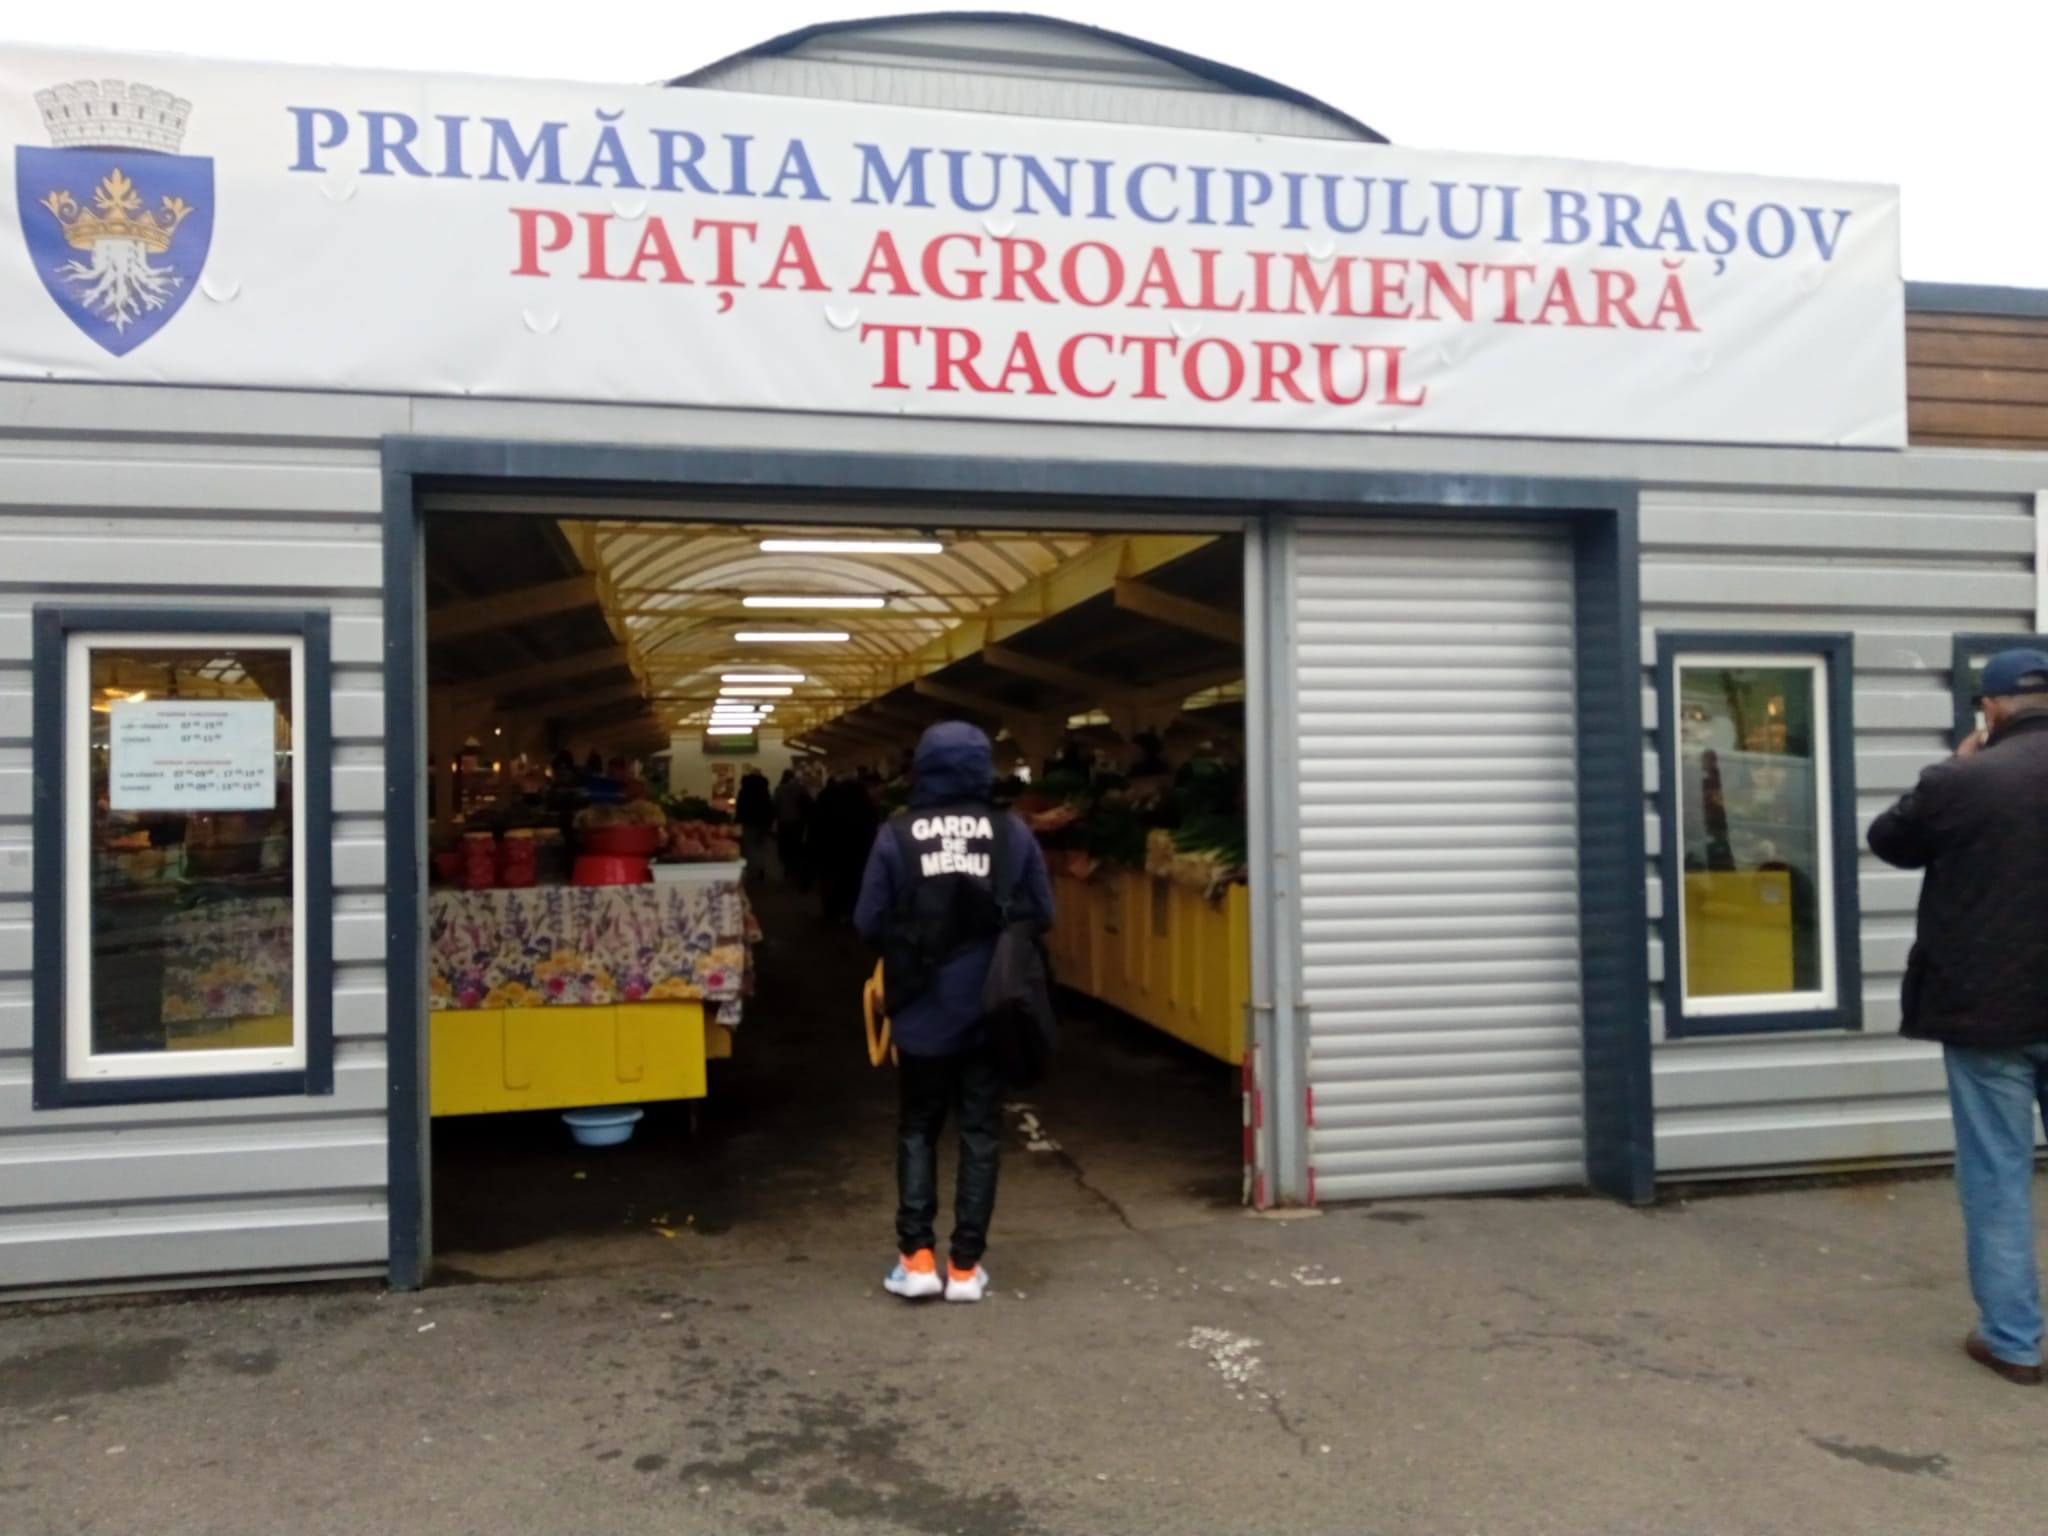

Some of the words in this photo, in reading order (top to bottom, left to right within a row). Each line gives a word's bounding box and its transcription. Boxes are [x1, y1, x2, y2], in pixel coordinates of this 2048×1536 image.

[287, 106, 831, 201] PRIMĂRIA
[851, 142, 1522, 243] MUNICIPIULUI
[1543, 187, 1853, 276] BRAȘOV
[509, 207, 832, 313] PIAȚA
[848, 230, 1703, 333] AGROALIMENTARĂ
[859, 322, 1427, 407] TRACTORUL
[911, 815, 993, 841] GARDA
[942, 838, 968, 854] DE
[921, 851, 990, 877] MEDIU
